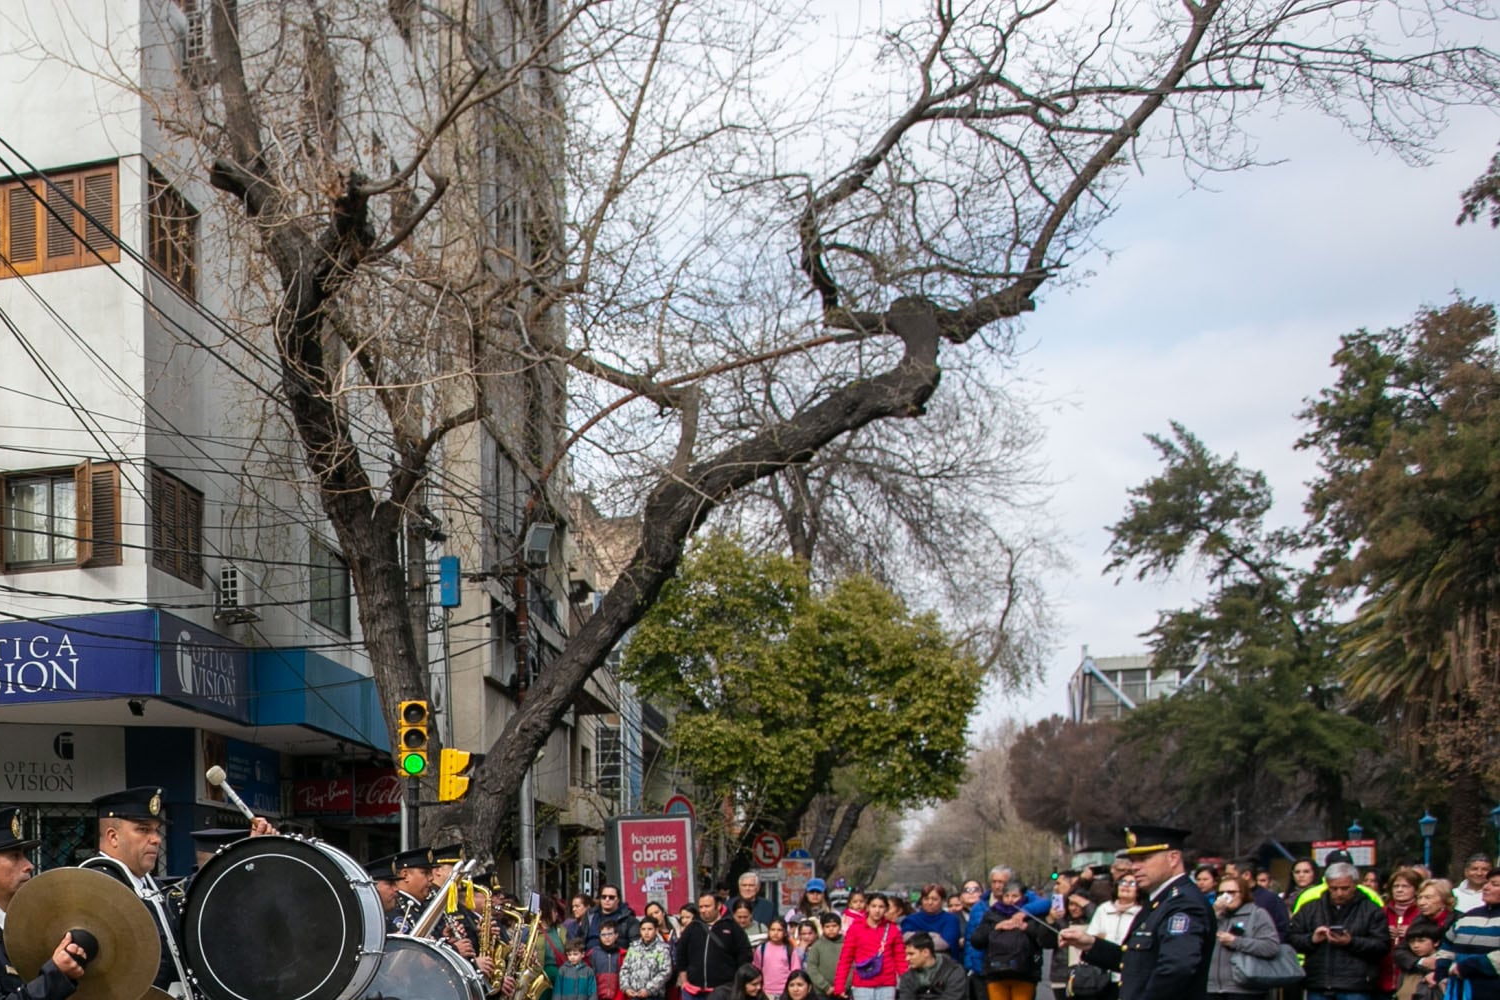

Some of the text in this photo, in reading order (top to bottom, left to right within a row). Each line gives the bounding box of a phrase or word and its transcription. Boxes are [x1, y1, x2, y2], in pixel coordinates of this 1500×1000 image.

[192, 641, 235, 677] OPTICA
[192, 663, 236, 707] VISION
[4, 761, 74, 774] OPTICA
[4, 774, 74, 792] VISION
[298, 780, 349, 807] Ray-Ban
[631, 833, 677, 845] hacemos
[632, 844, 678, 863] obras
